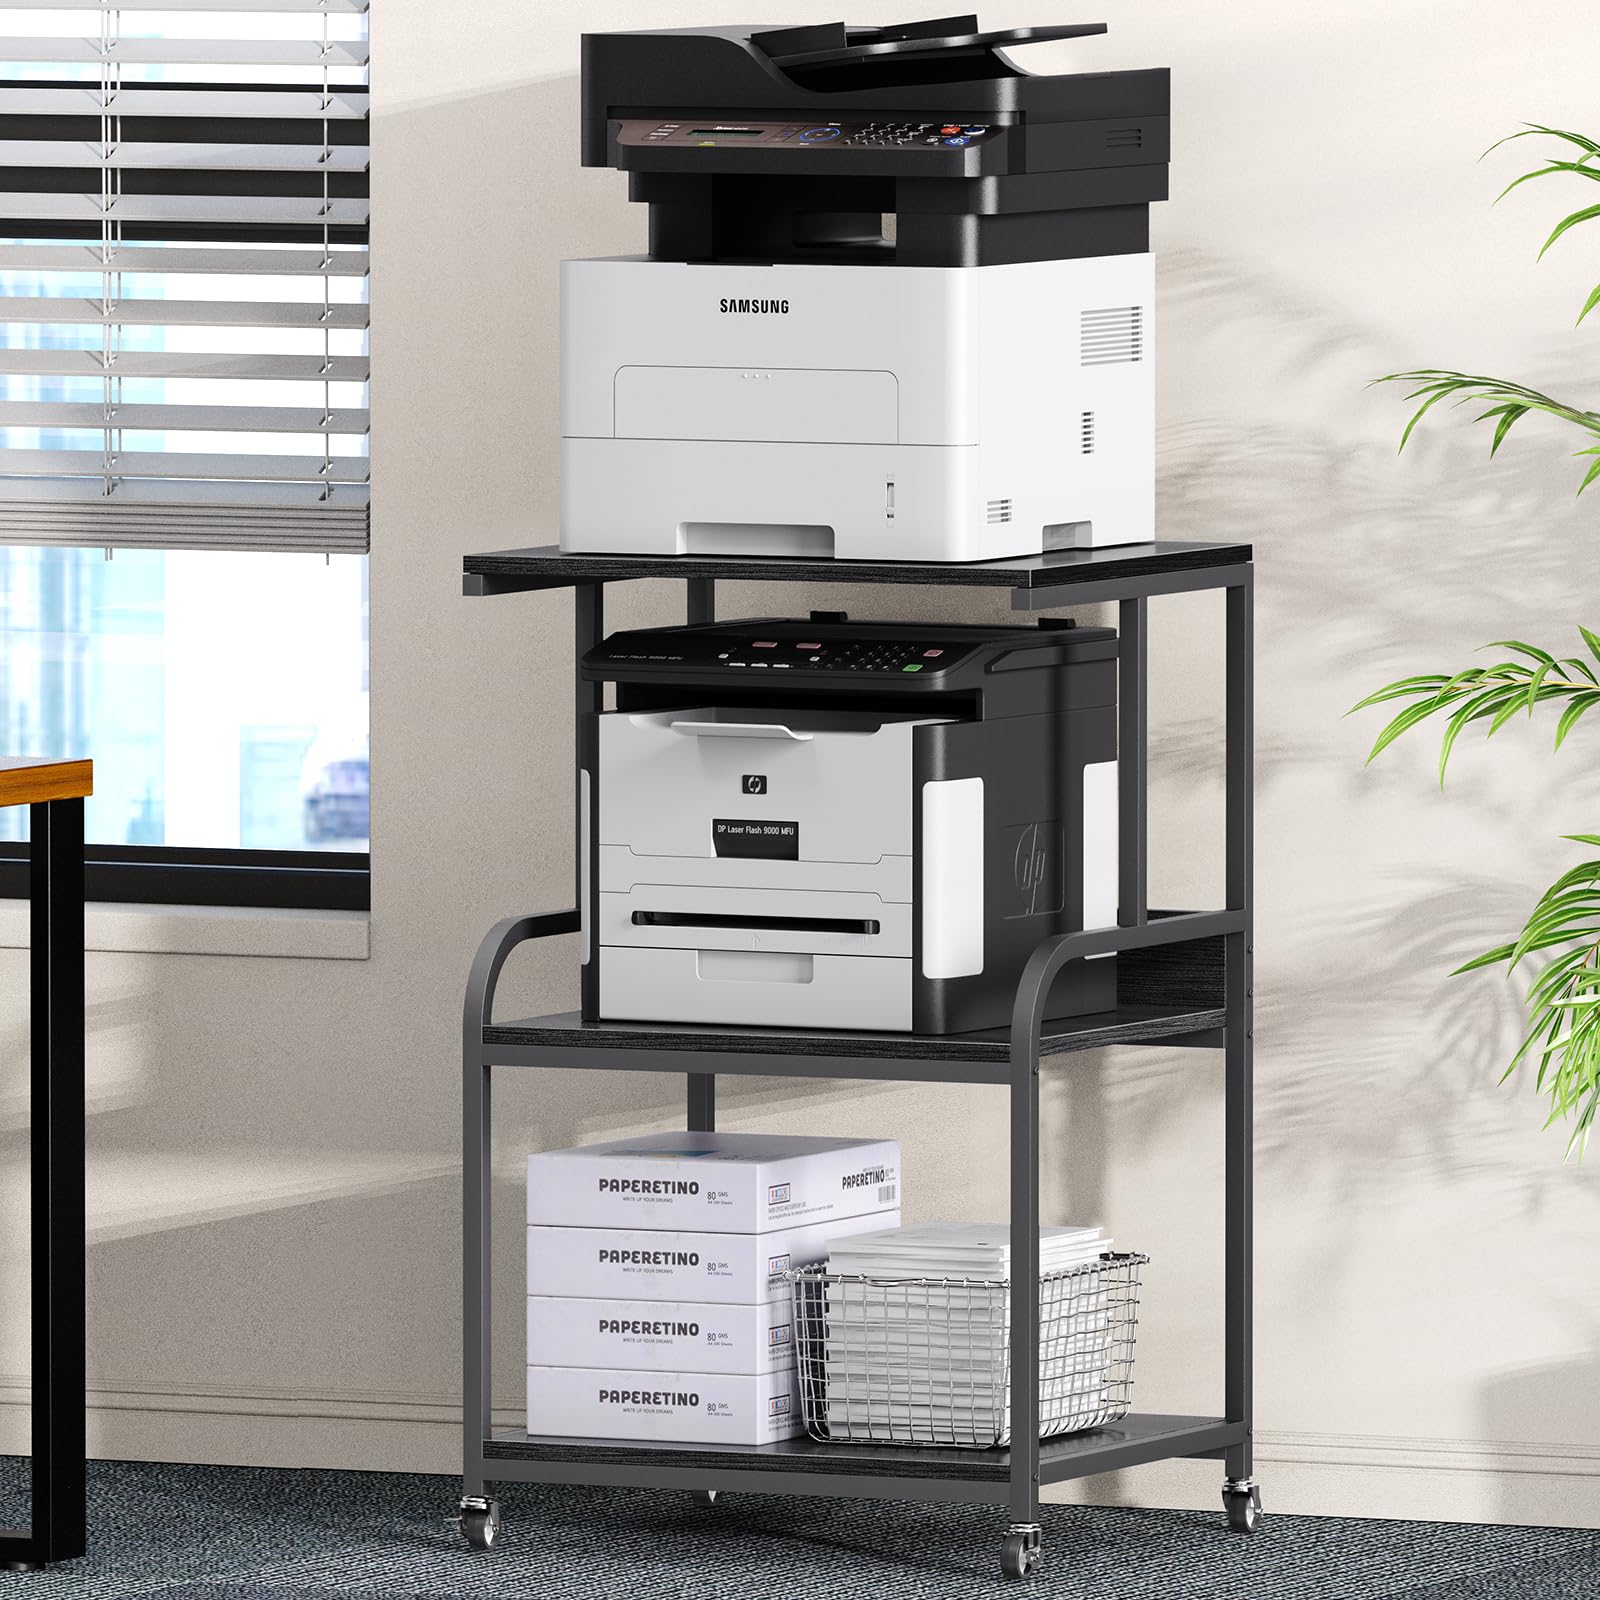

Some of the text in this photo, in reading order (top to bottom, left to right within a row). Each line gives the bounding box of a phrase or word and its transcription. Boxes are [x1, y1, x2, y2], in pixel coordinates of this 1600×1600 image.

[719, 298, 789, 314] SAMSUNG
[717, 825, 726, 833] DP
[727, 825, 744, 834] Laser
[745, 826, 762, 834] Flash
[763, 826, 780, 835] 9000
[599, 1179, 700, 1196] PAPERETINO
[842, 1169, 885, 1190] PAPERETINO
[707, 1192, 717, 1200] 80
[599, 1250, 700, 1267] PAPERETINO
[707, 1263, 717, 1271] 80
[599, 1320, 700, 1337] PAPERETINO
[707, 1333, 717, 1341] 80
[599, 1390, 700, 1407] PAPERETINO
[707, 1403, 717, 1411] 80
